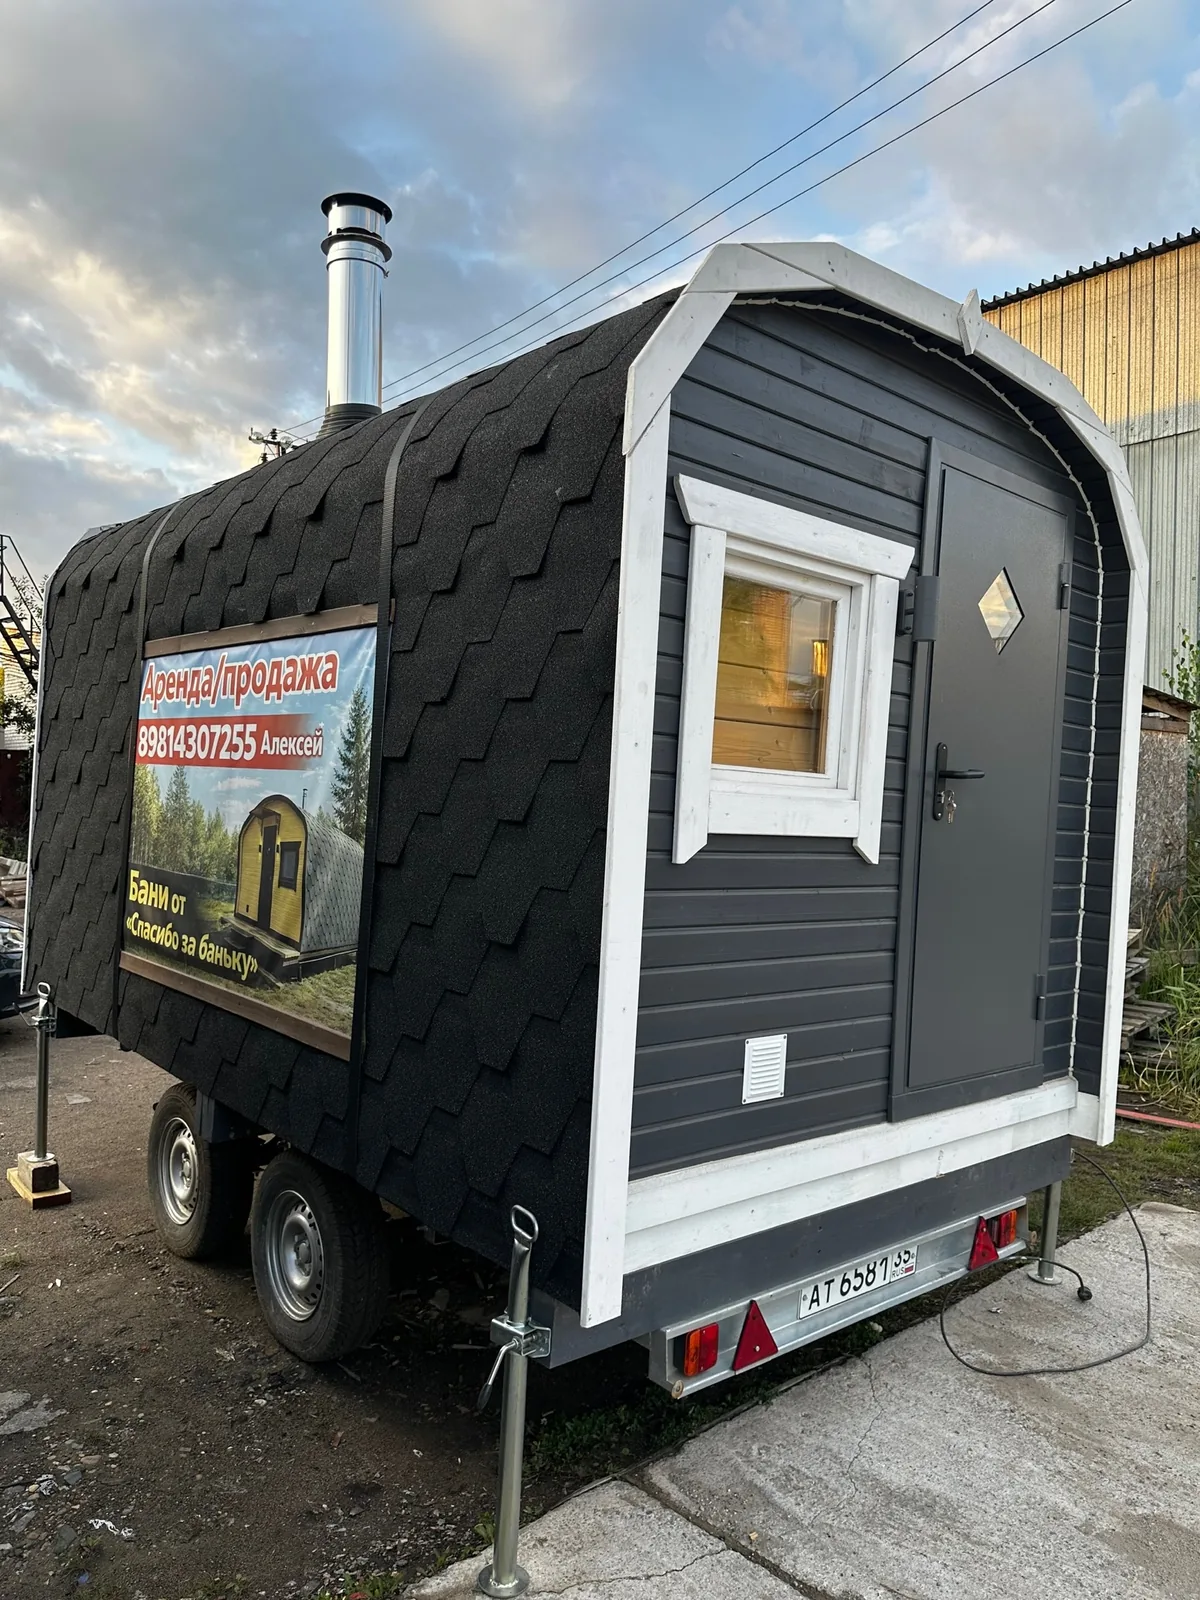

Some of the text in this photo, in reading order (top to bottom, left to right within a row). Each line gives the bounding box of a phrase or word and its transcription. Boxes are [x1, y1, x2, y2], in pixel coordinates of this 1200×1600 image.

[141, 651, 339, 712] Аренда/продажа
[138, 723, 323, 761] 89814307255 Алексей
[129, 869, 187, 916] Бани от
[126, 911, 259, 981] «Спасибо за баньку»
[840, 1256, 888, 1297] 6581
[892, 1266, 905, 1279] RUS
